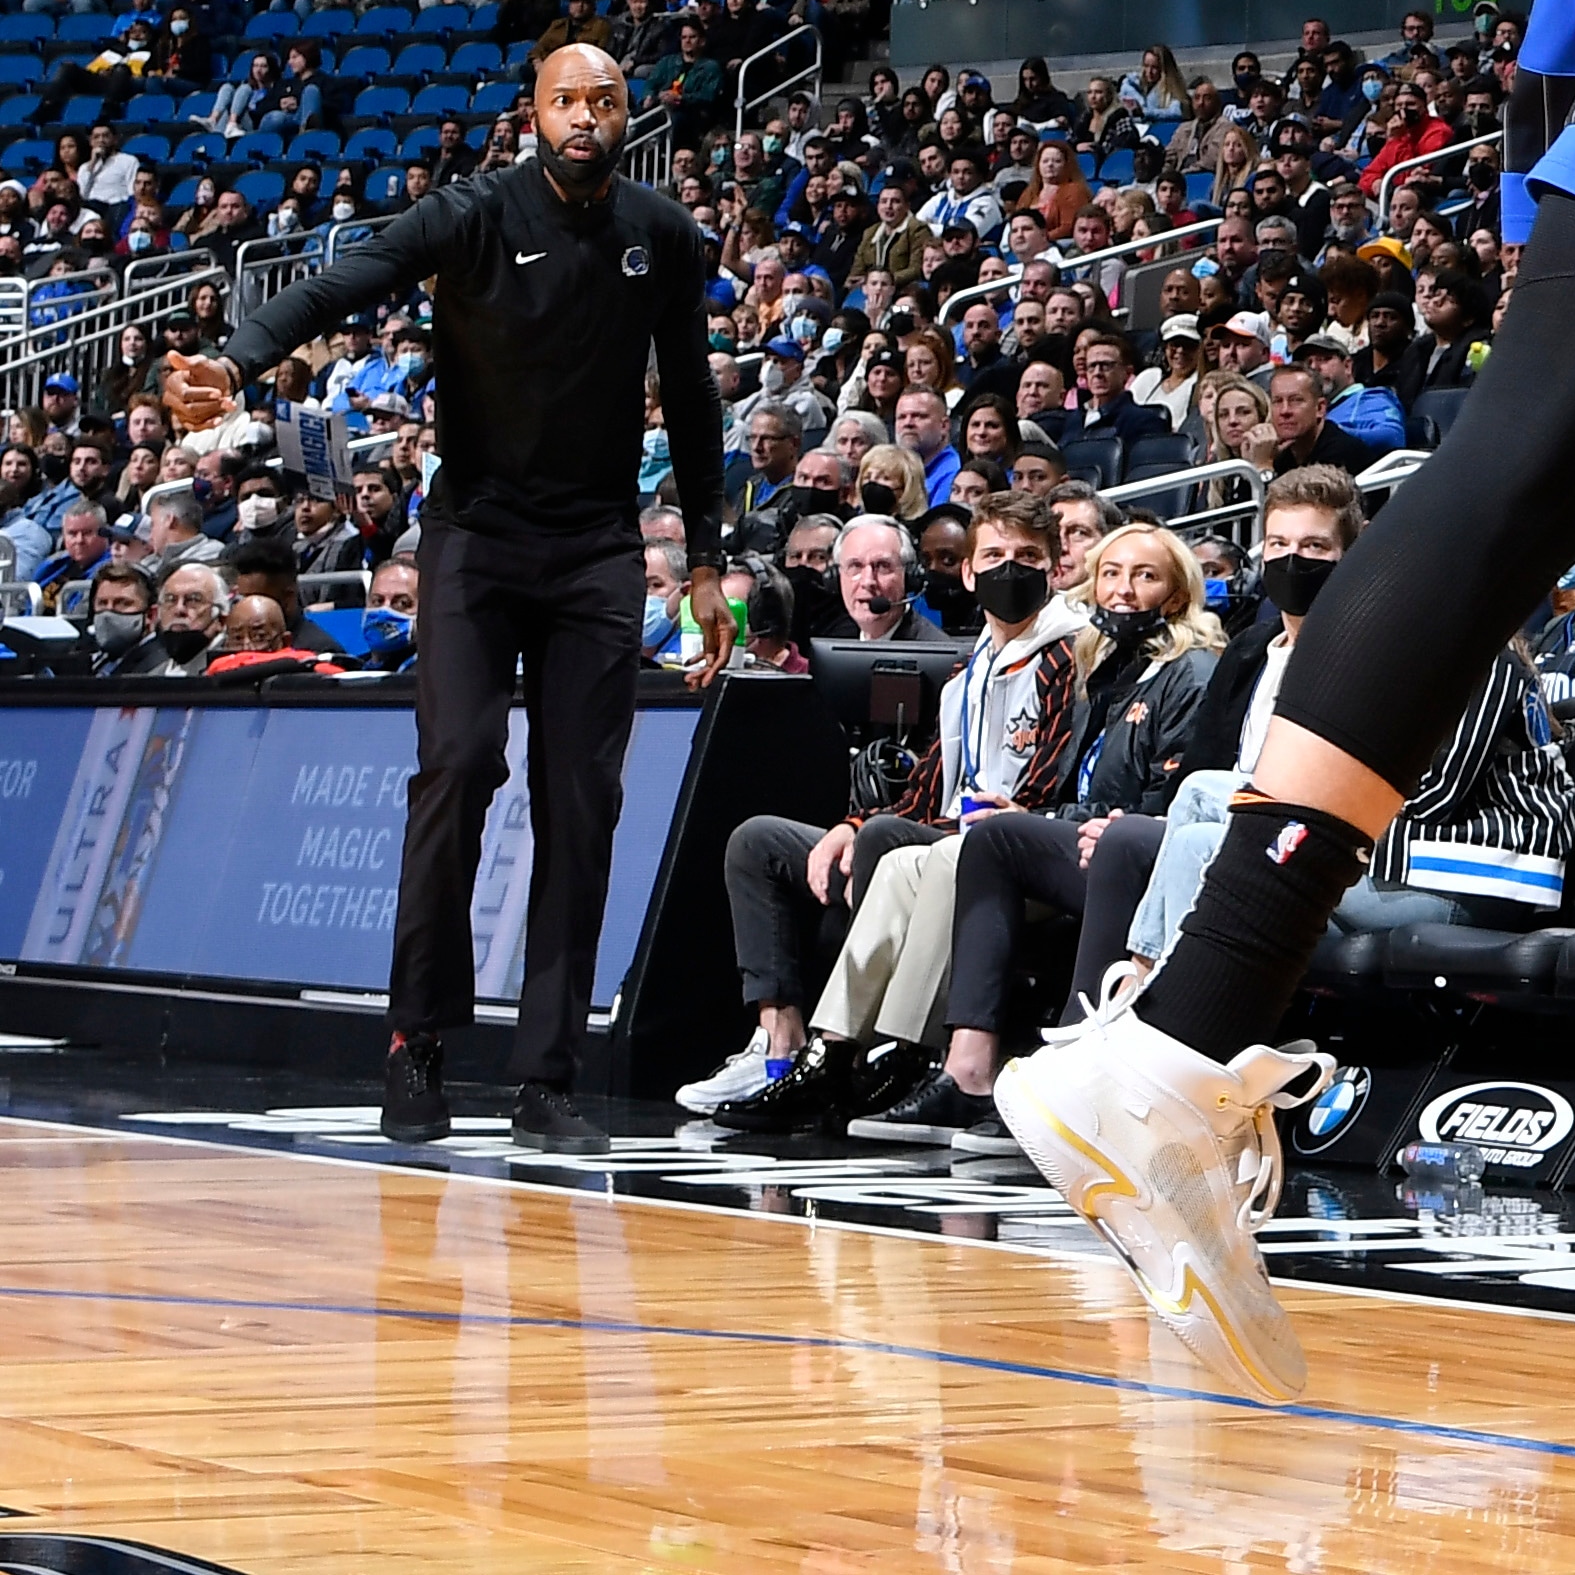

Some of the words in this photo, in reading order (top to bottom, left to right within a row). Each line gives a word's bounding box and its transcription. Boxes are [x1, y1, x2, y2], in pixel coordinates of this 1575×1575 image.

[290, 764, 374, 807] MADE
[375, 765, 415, 809] FO
[48, 737, 129, 946] ULTRA
[296, 825, 392, 871] MAGIC
[472, 759, 531, 975] ULTR
[257, 882, 400, 931] TOGETHER
[1438, 1101, 1556, 1146] FIELDS
